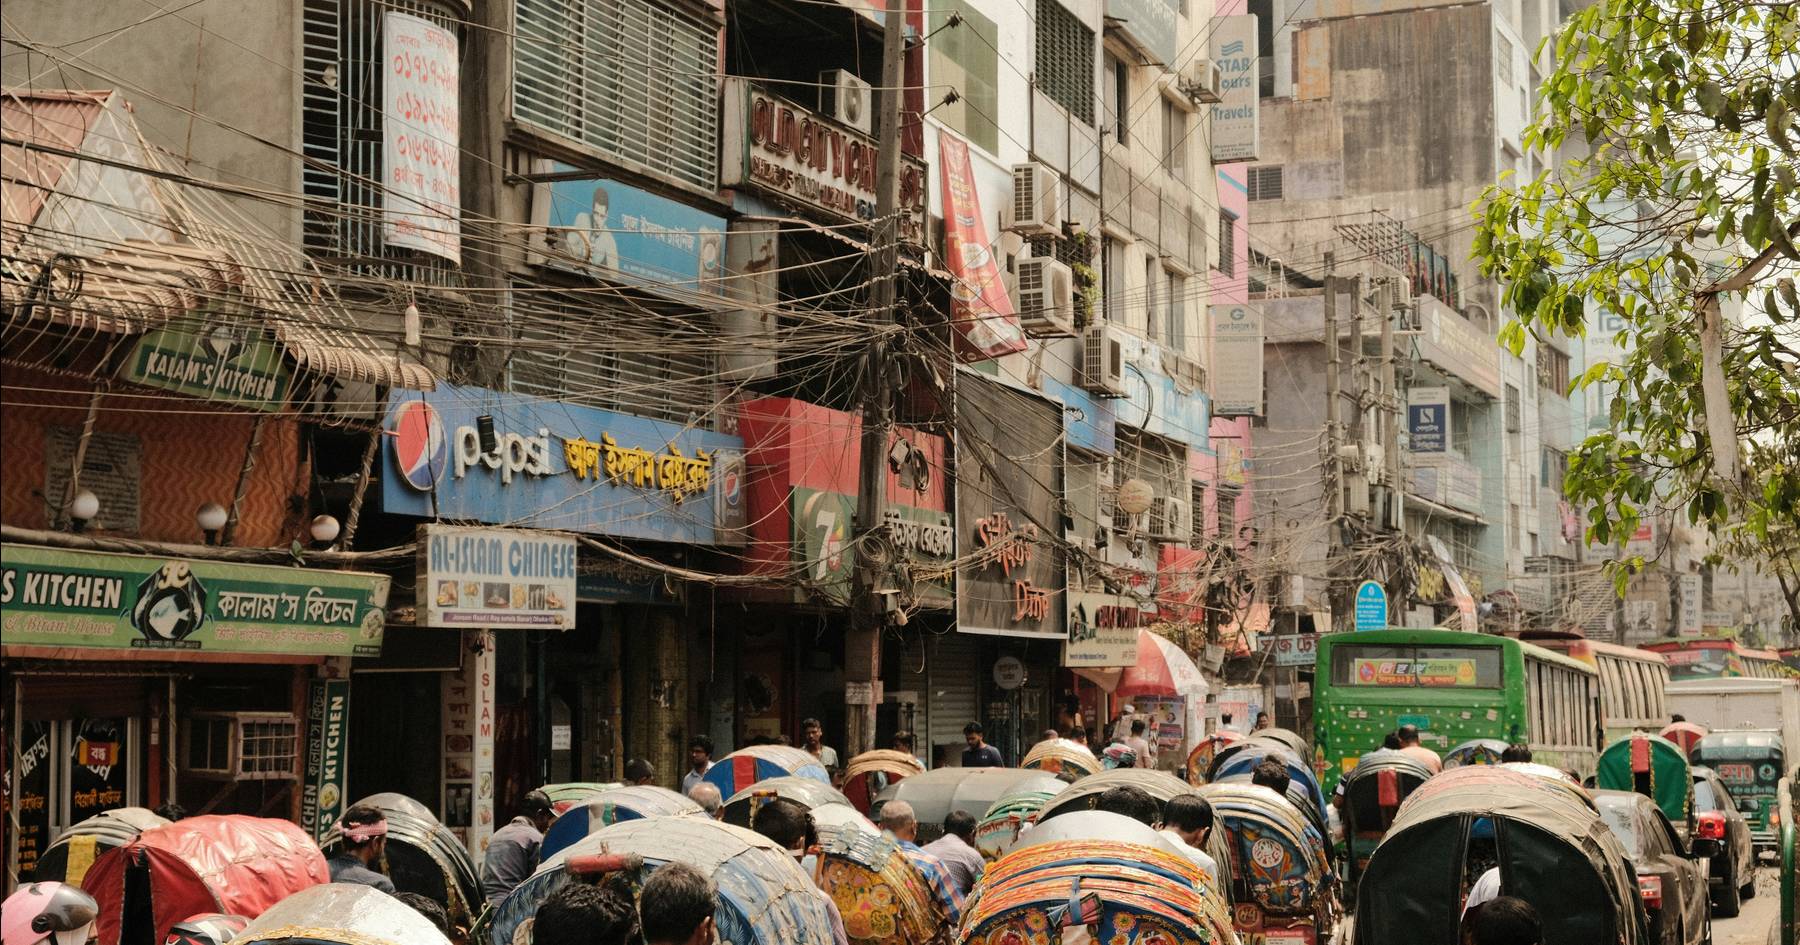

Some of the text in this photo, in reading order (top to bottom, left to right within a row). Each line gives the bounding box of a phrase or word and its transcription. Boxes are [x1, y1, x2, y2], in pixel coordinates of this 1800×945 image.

[1221, 76, 1250, 90] ours
[1212, 103, 1254, 121] Travels
[751, 97, 795, 157] OLD
[794, 117, 848, 179] CITY
[145, 351, 277, 400] KALAM'S KITCHEN
[564, 437, 600, 481] আল
[602, 431, 655, 487] ইসলাম
[431, 534, 503, 575] AL-ISLAM
[508, 540, 575, 579] CHINESE
[23, 572, 123, 609] KITCHEN
[304, 586, 358, 625] কিচেন
[91, 746, 107, 760] বন্ধ
[324, 696, 344, 781] KITCHEN
[301, 784, 317, 836] TCHEN
